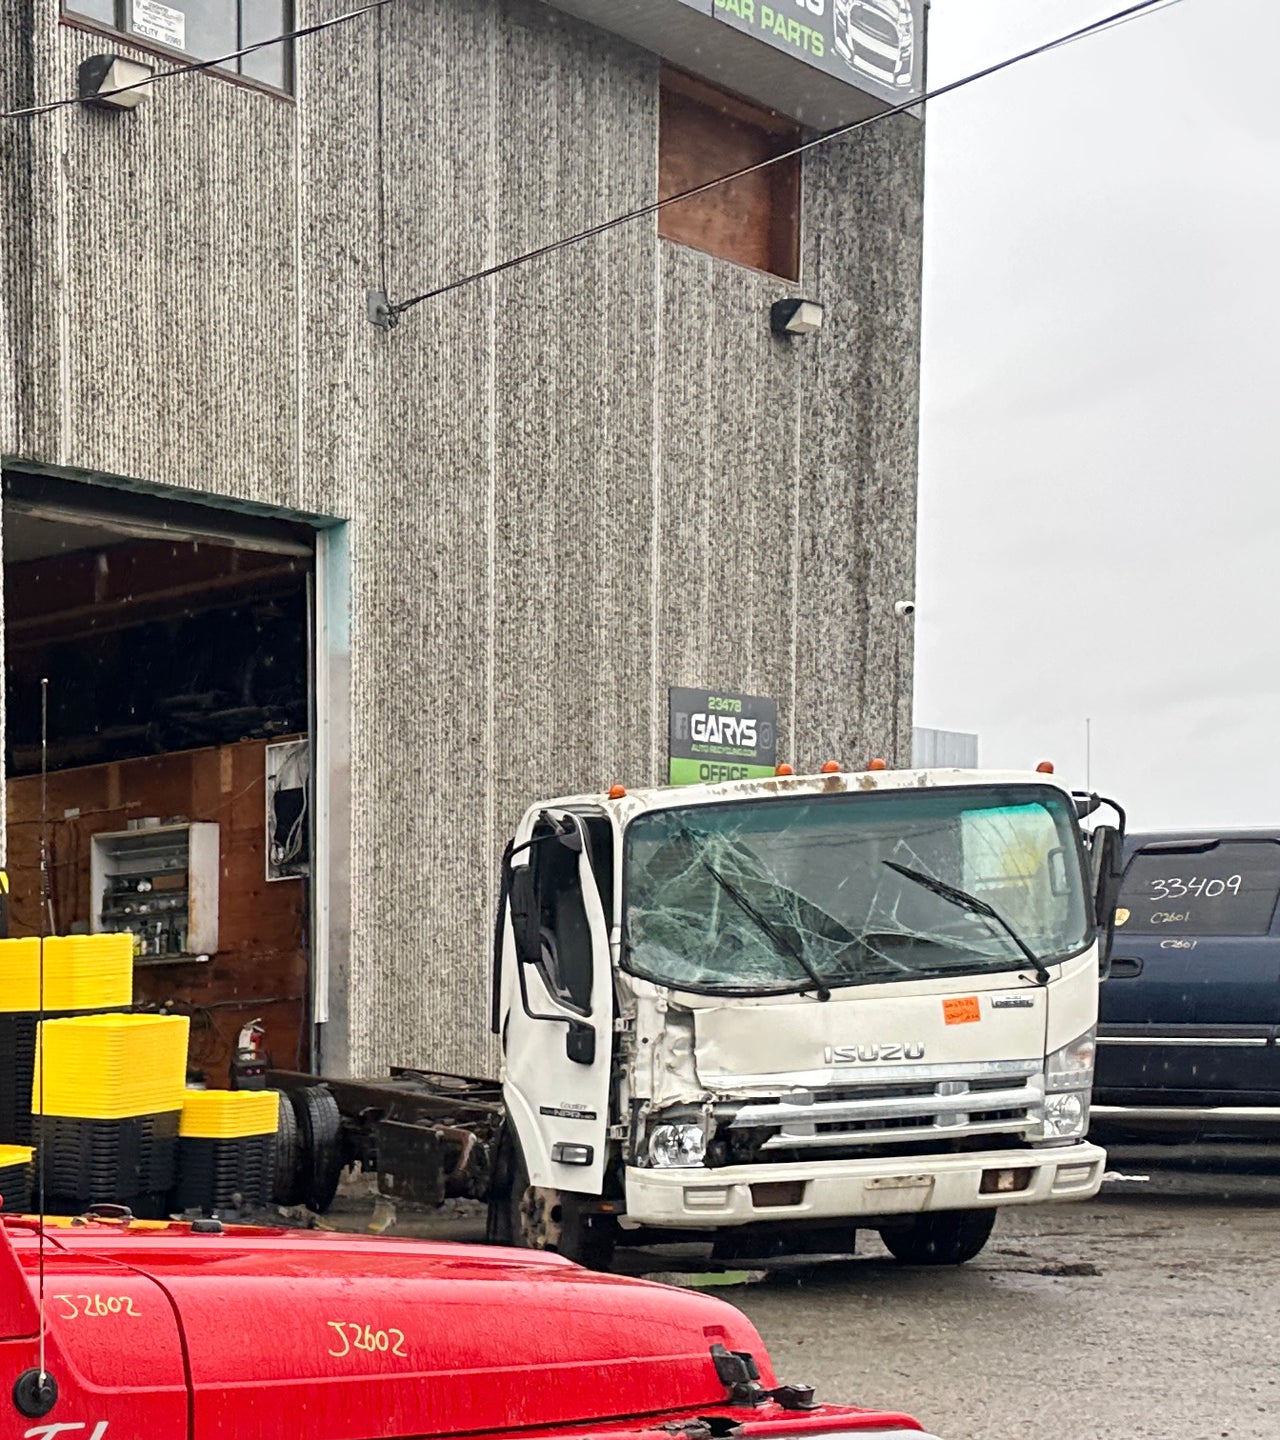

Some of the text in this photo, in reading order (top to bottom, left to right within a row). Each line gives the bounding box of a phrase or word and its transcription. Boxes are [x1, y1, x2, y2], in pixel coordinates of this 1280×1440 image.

[761, 5, 825, 56] PARTS
[708, 697, 742, 712] 23478
[691, 713, 757, 747] GARYS
[700, 764, 748, 780] OFFICE
[1150, 875, 1242, 900] 33409
[1151, 912, 1190, 924] C2601
[824, 1042, 925, 1064] ISUZU
[53, 1294, 142, 1319] J2602
[327, 1321, 407, 1357] J2602
